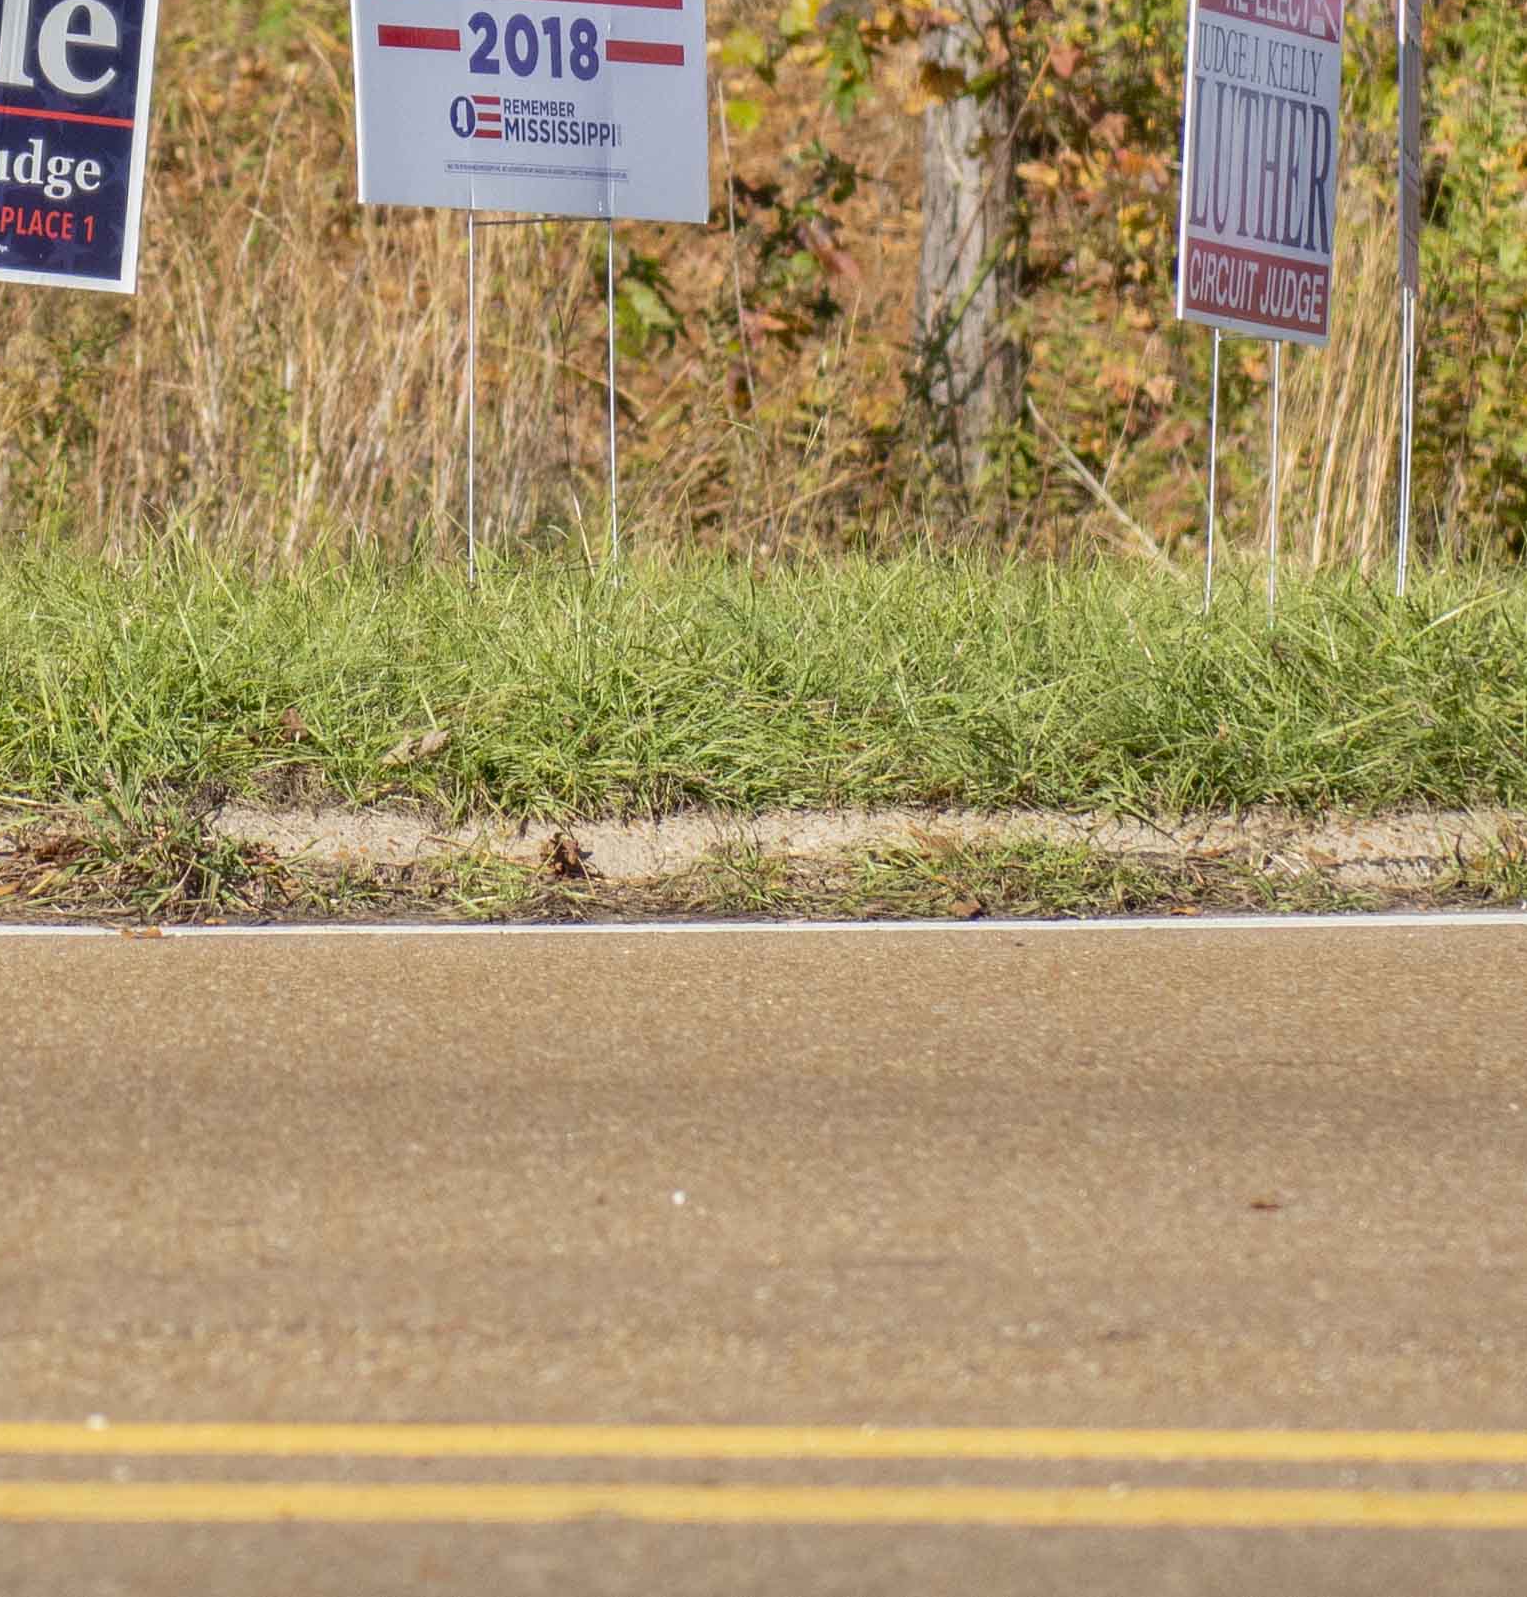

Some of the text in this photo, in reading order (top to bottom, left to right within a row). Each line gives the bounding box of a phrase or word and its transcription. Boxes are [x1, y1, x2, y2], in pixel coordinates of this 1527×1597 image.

[467, 11, 600, 82] 2018
[1196, 21, 1248, 80] JUDGE
[1267, 39, 1323, 97] KELLY
[503, 98, 575, 117] REMEMBER
[505, 118, 616, 147] MISSISSIPPI
[1189, 75, 1331, 255] LUTHER
[1, 206, 75, 241] PLACE
[84, 215, 95, 243] 1
[1188, 248, 1323, 325] CIRCUIT JUDGE
